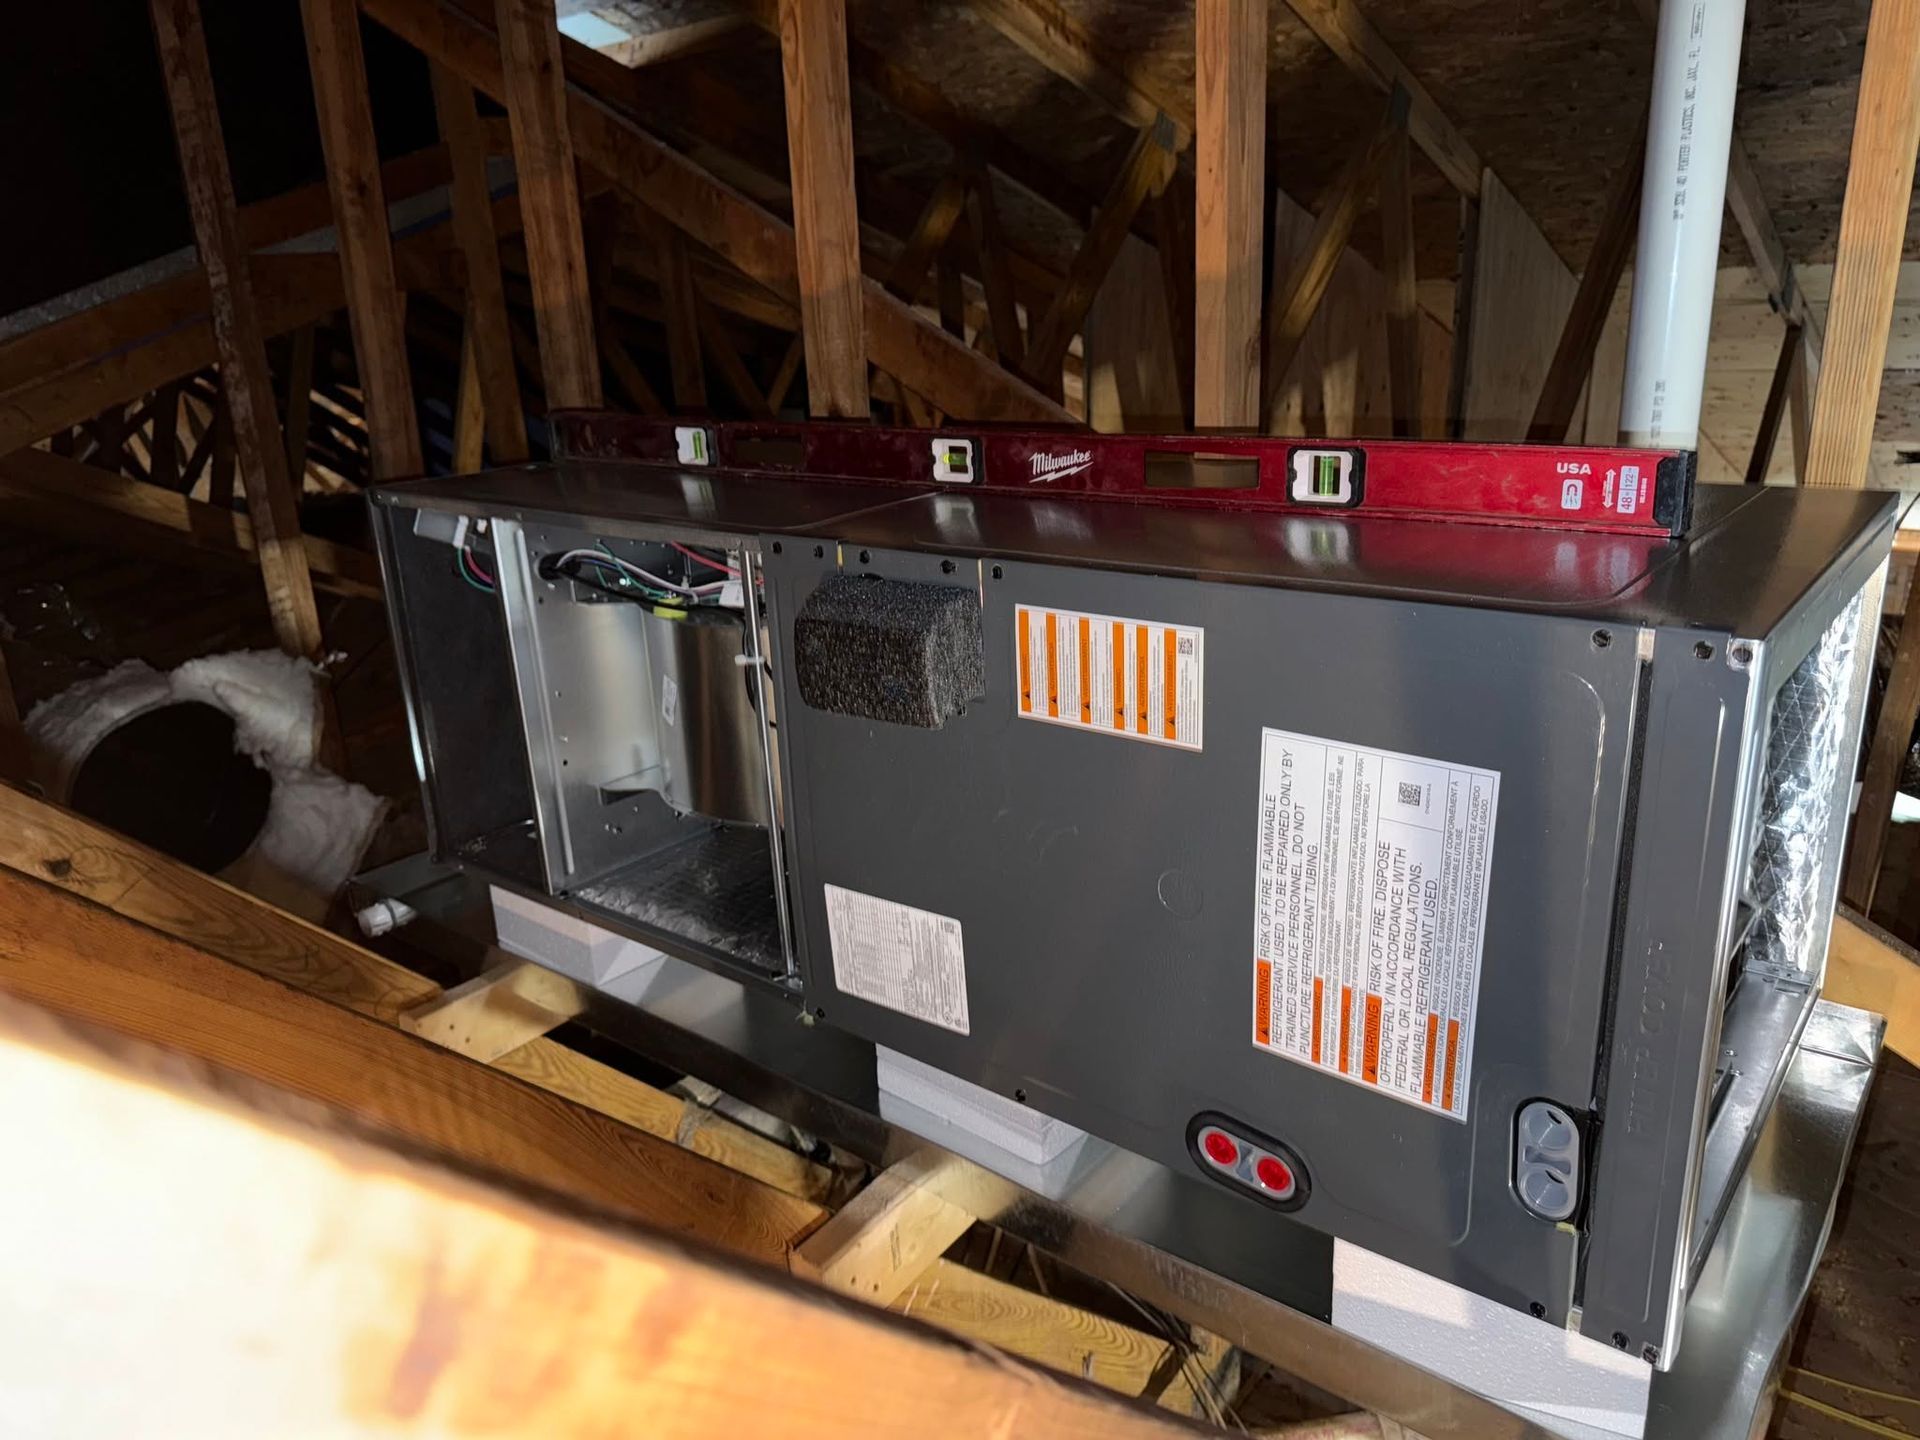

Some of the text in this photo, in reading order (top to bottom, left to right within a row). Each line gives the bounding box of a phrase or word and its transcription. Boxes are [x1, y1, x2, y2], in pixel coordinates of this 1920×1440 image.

[1028, 449, 1092, 475] Milwaukee
[1556, 462, 1592, 475] USA
[1262, 793, 1276, 871] FLAMMABLE
[1292, 833, 1304, 854] DO
[1293, 802, 1306, 831] NOT
[1392, 846, 1407, 884] WITH
[1260, 908, 1272, 927] OF
[1270, 748, 1293, 1044] REFRIGERANT USED. TO BE REPAIRED ONLY BY
[1259, 928, 1271, 958] RISK
[1297, 840, 1319, 1055] PUNCTURE REFRIGERANT TUBING.
[1364, 839, 1390, 1064] WARNING RISK OF FIRE. DISPOSE
[1385, 885, 1404, 980] ACCORDANCE
[1286, 939, 1299, 995] SERVICE
[1384, 981, 1397, 996] IN
[1394, 860, 1423, 1089] FEDERAL OR LOCAL REGULATIONS.
[1409, 875, 1438, 1095] FLAMMABLE REFRIGERANT USED.
[1257, 967, 1269, 1026] WARNING
[1284, 995, 1297, 1049] TRAINED
